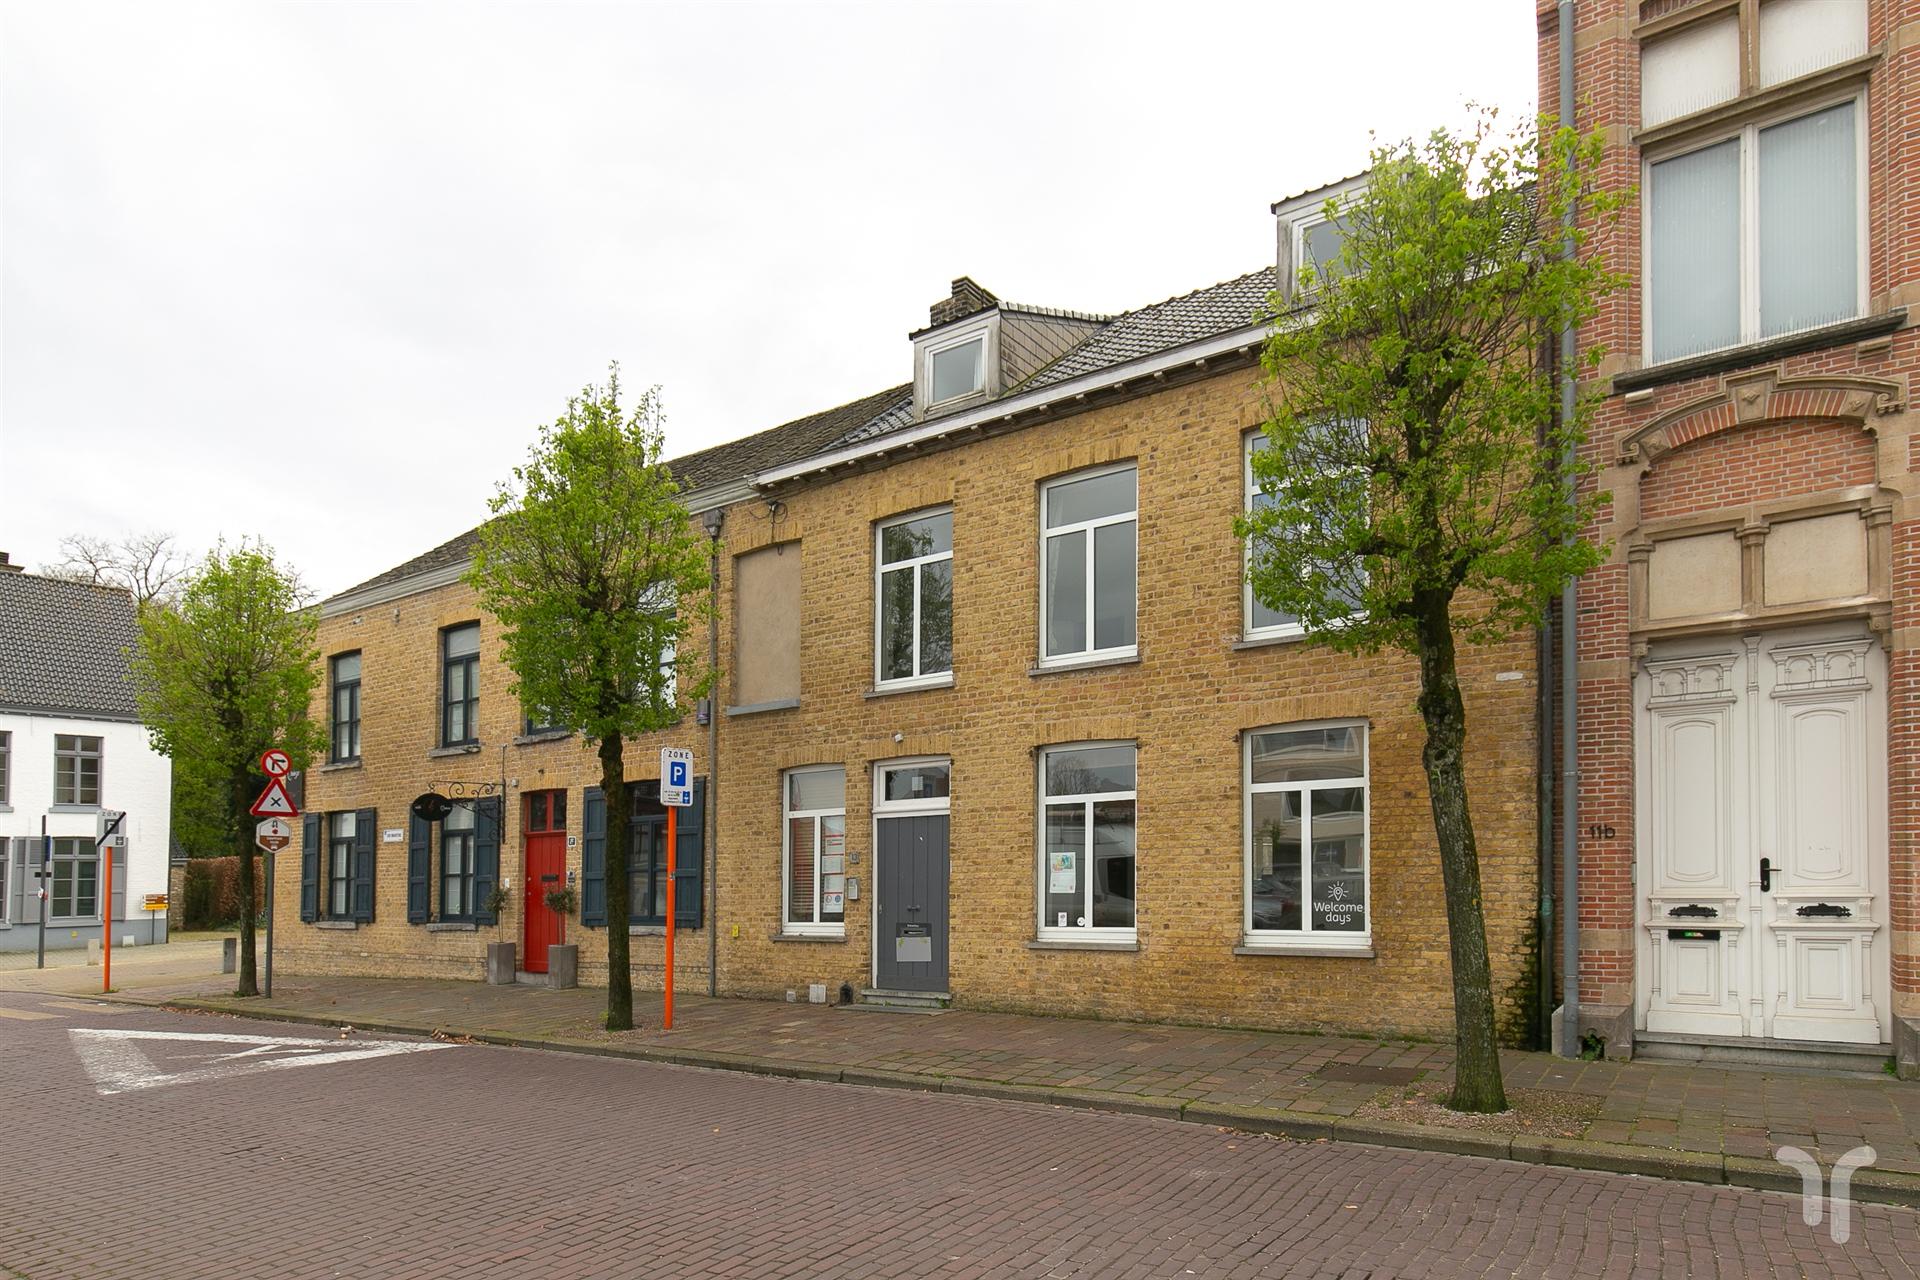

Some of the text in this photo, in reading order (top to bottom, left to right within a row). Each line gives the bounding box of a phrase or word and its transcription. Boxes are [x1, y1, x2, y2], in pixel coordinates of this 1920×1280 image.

[668, 751, 690, 759] ZONE
[673, 766, 683, 782] P
[1590, 824, 1616, 839] 11b
[1313, 901, 1364, 912] Welcome
[1325, 911, 1352, 925] days
